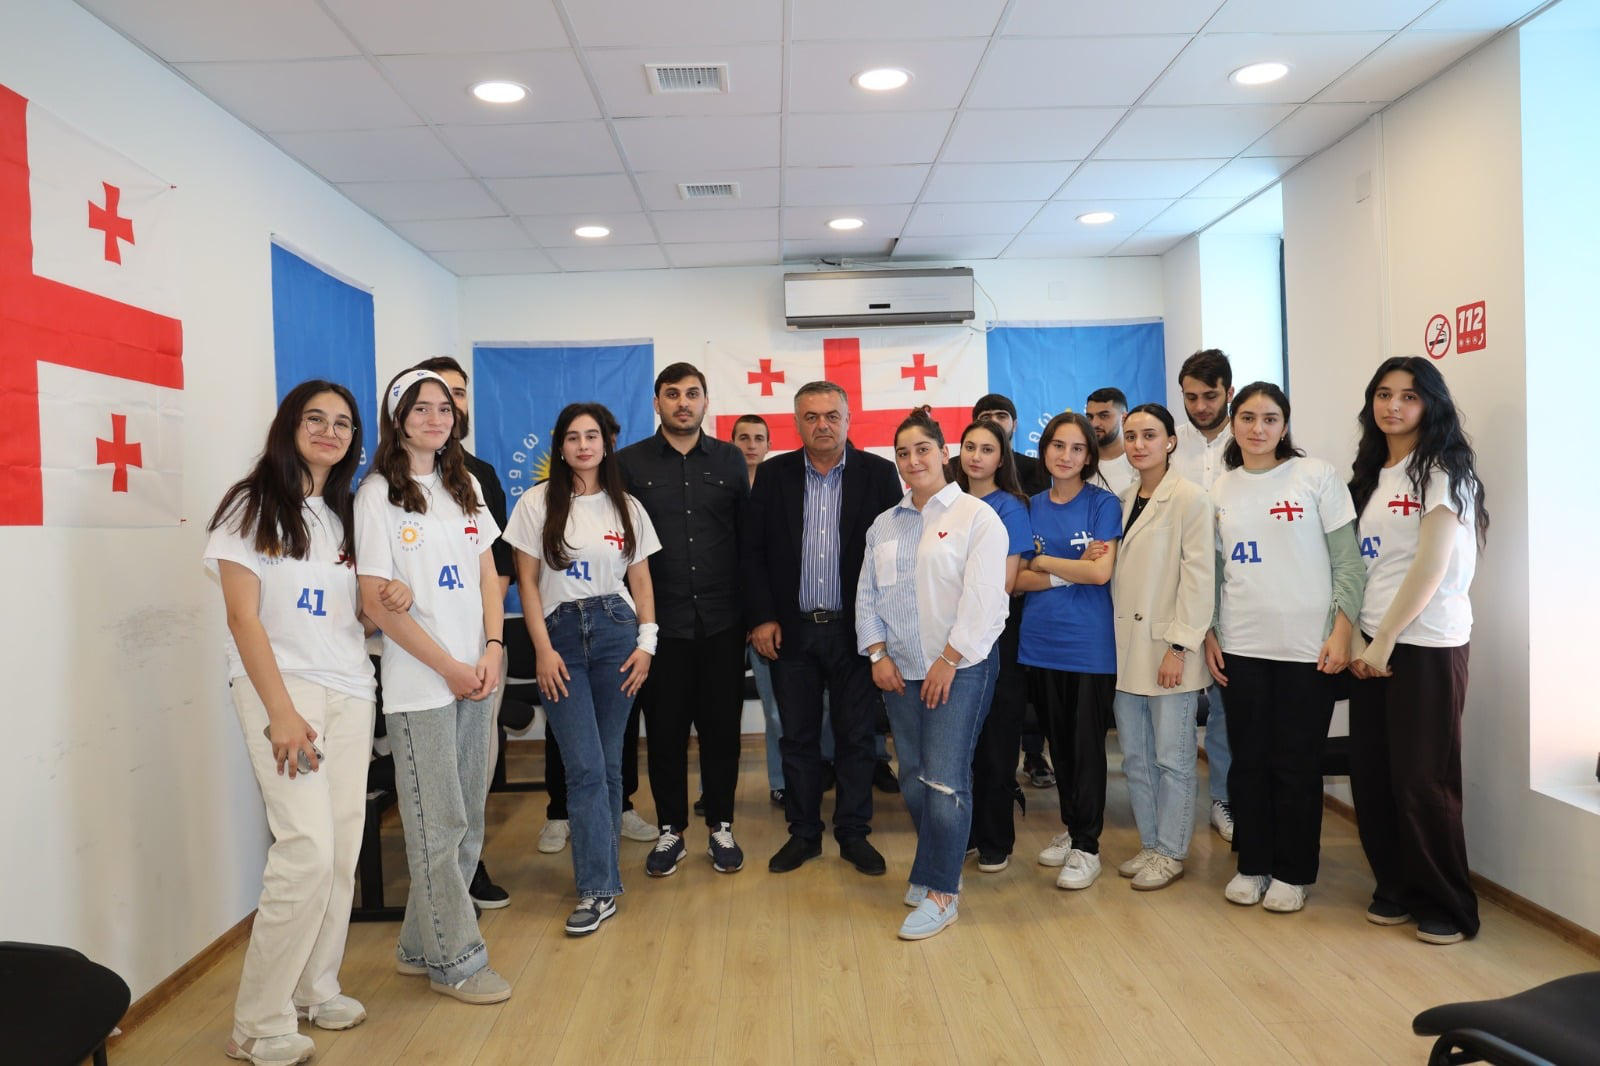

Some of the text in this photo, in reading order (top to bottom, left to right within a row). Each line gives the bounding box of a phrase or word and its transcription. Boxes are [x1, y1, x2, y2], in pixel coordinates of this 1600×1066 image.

[1459, 306, 1483, 334] 112
[509, 432, 540, 497] ოცნე
[1231, 541, 1262, 563] 41
[438, 564, 464, 590] 41
[566, 560, 592, 581] 41
[296, 587, 327, 616] 41
